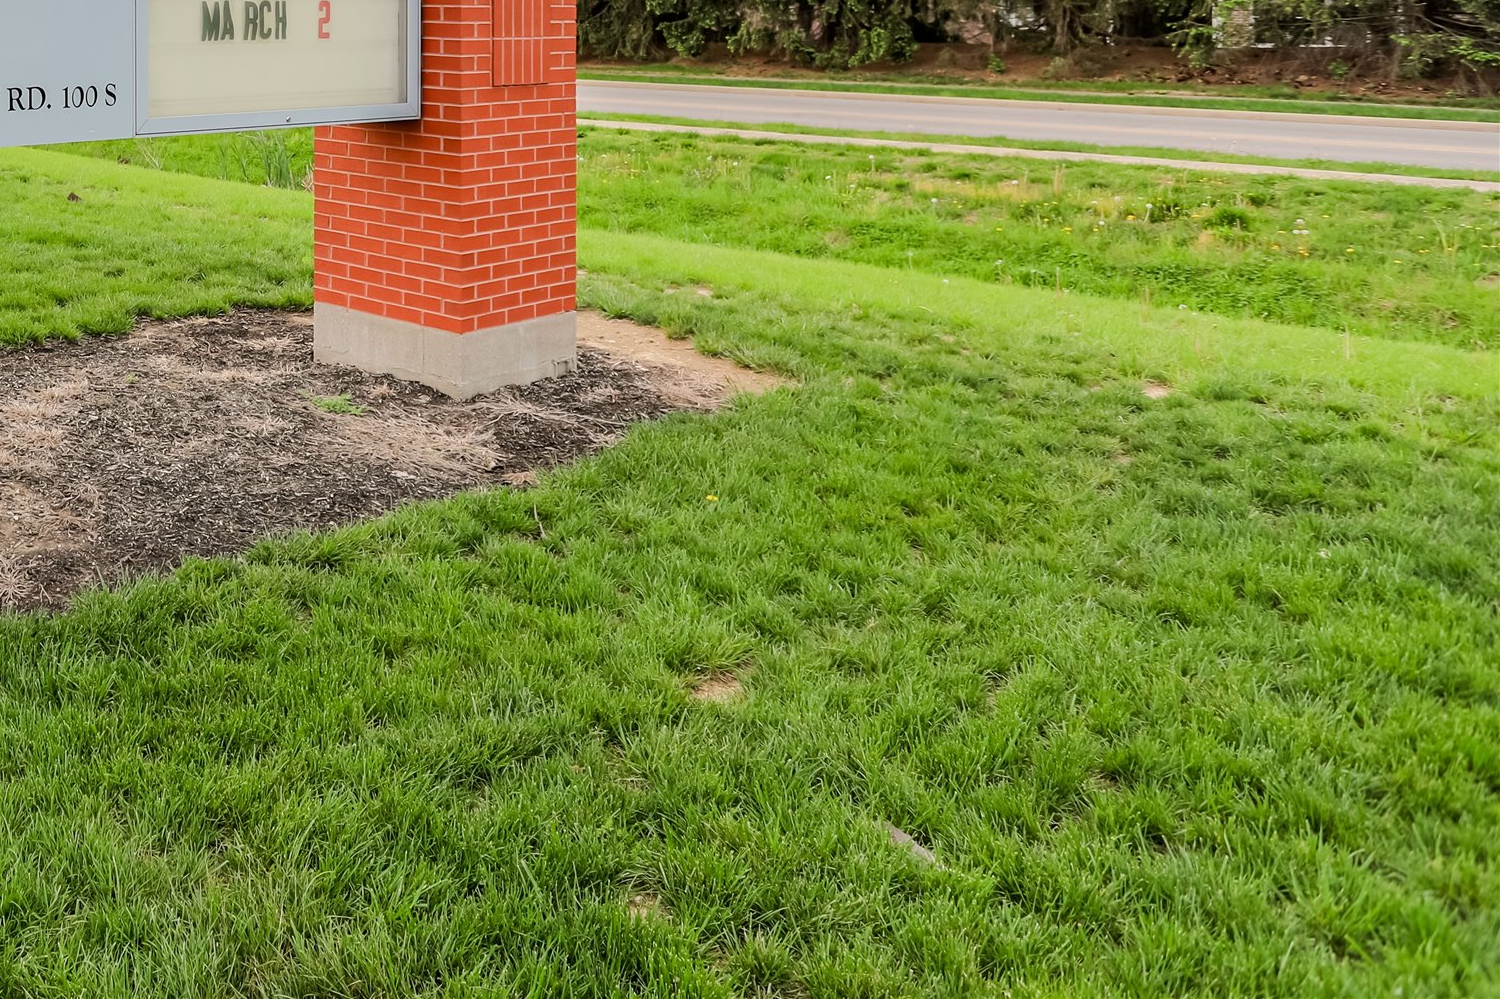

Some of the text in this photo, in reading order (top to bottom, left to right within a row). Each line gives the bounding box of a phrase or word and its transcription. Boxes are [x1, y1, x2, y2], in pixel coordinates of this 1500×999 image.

[201, 0, 331, 41] MARCH 2
[7, 85, 52, 112] RD.
[62, 85, 98, 110] 100
[105, 83, 117, 107] S
